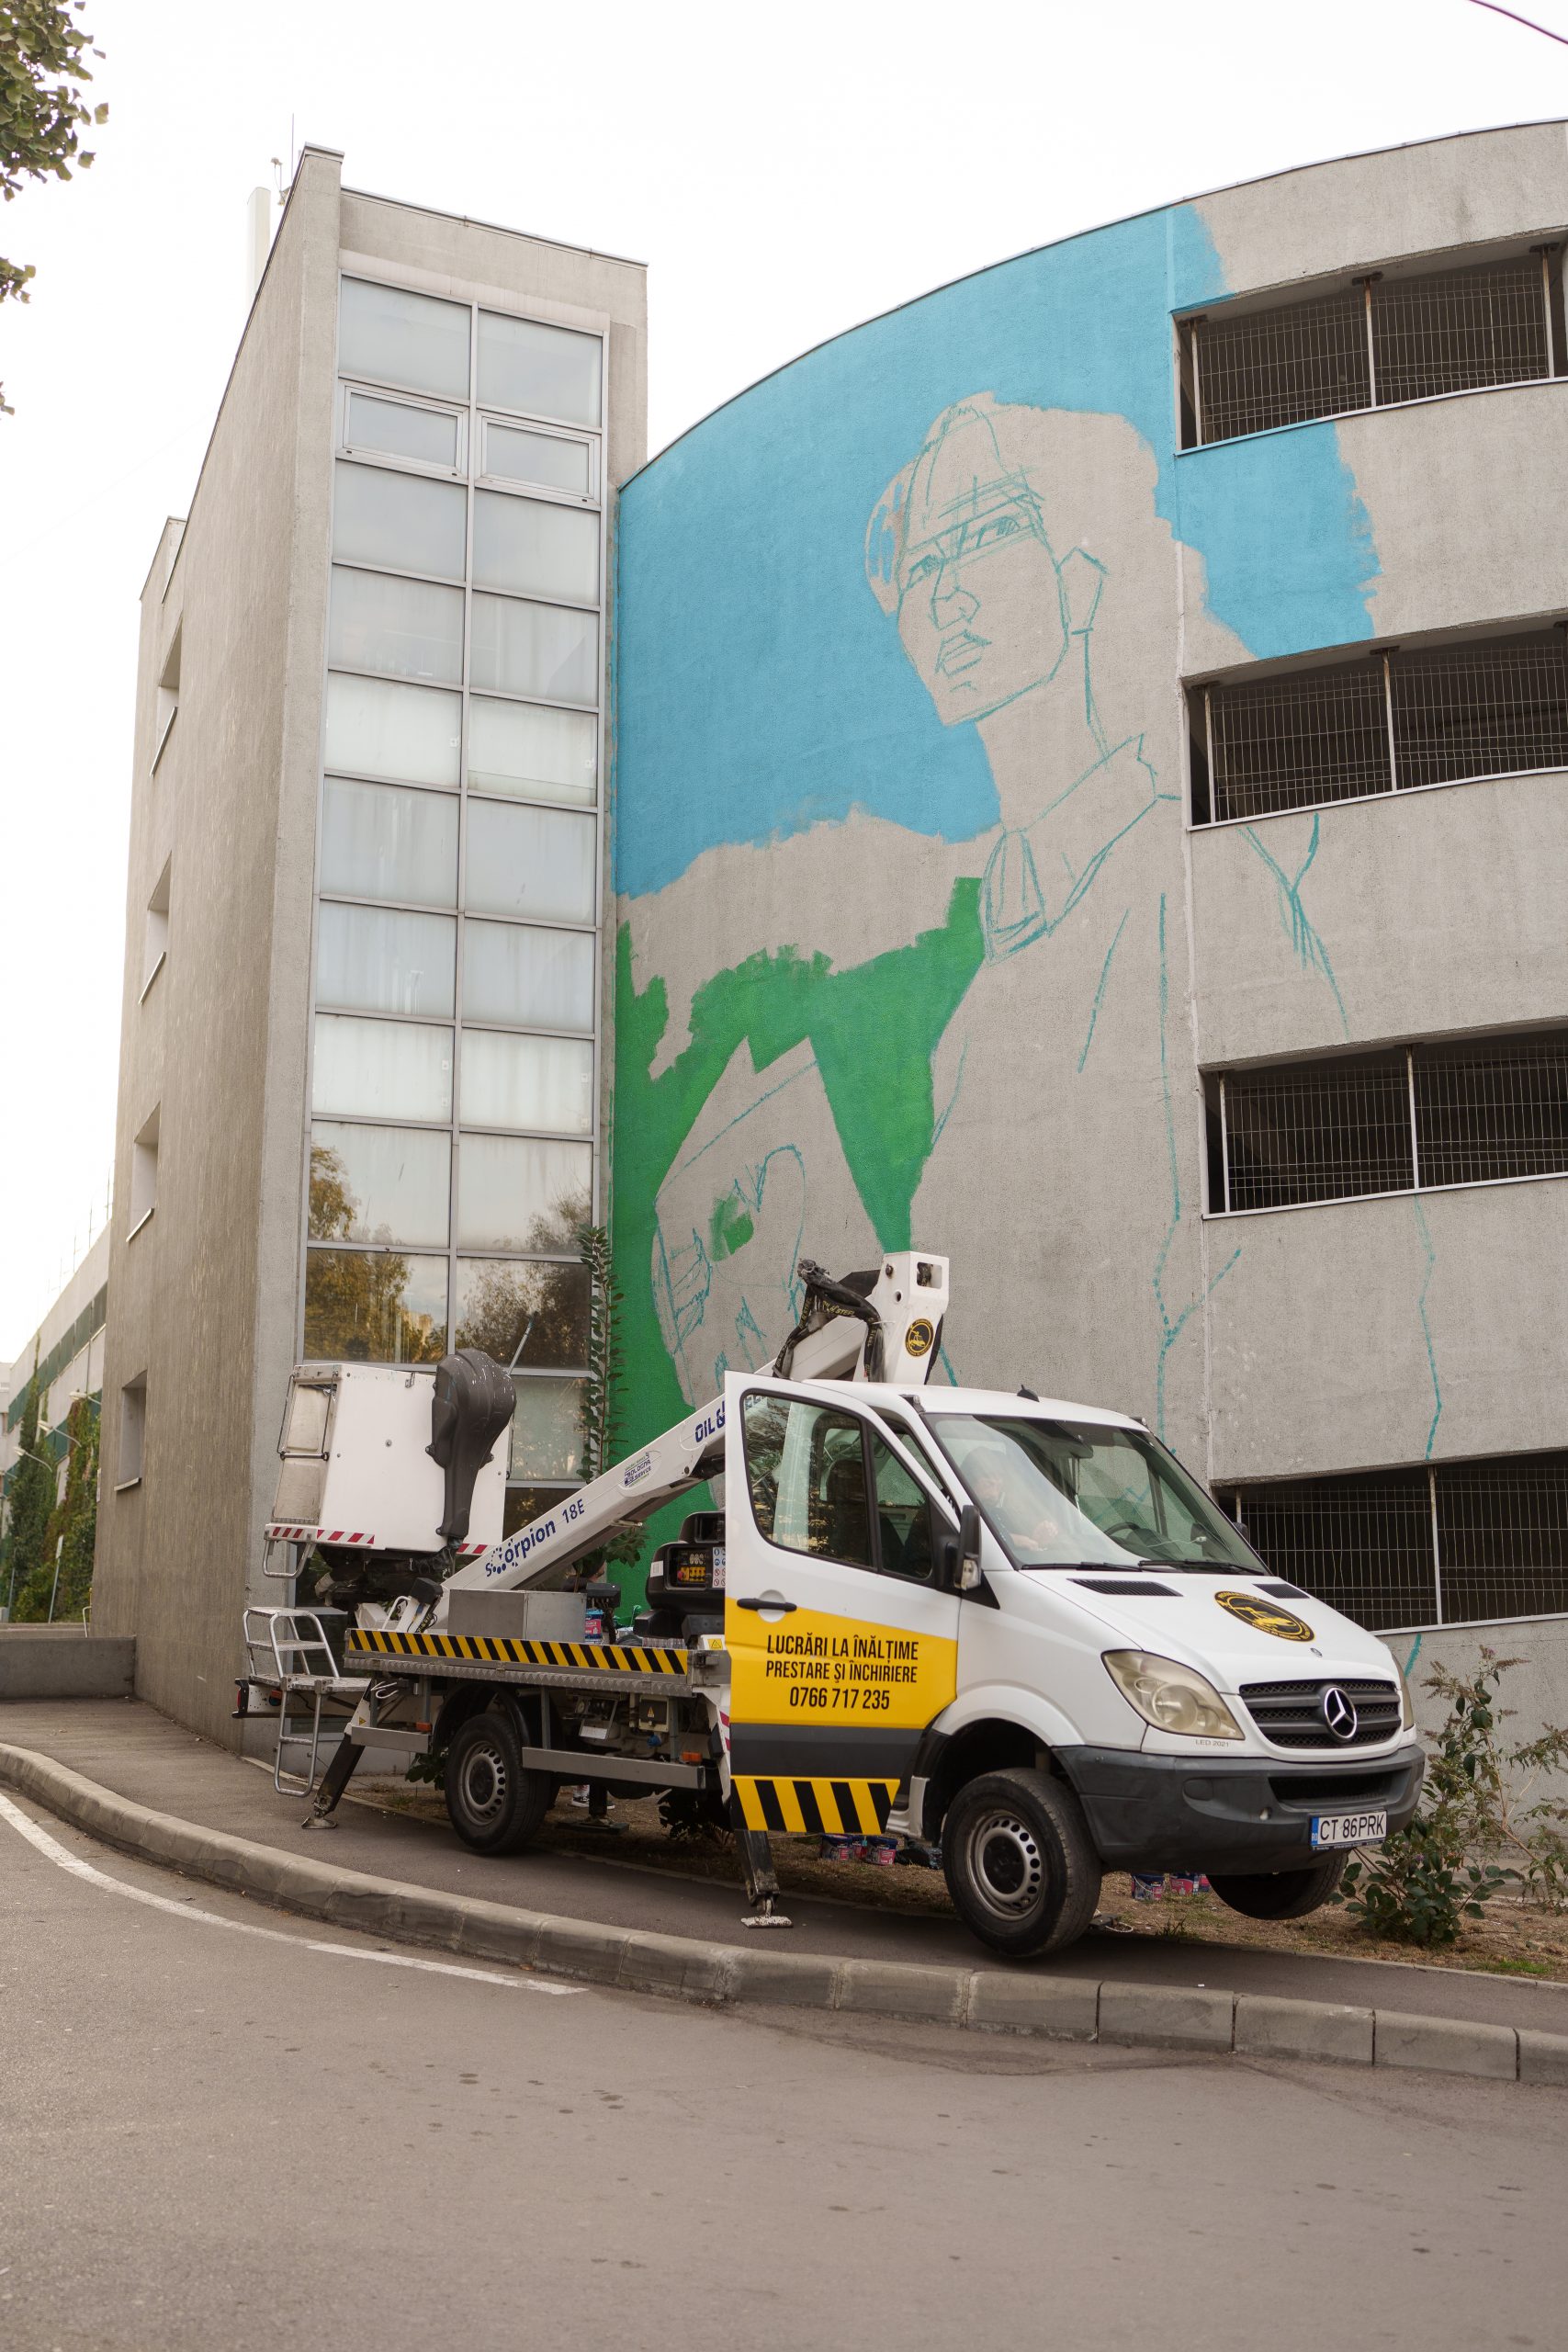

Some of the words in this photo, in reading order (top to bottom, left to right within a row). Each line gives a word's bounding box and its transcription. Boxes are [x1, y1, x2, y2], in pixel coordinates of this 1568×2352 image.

[562, 1498, 585, 1523] 18E
[767, 1632, 829, 1657] LUCRĂRI
[832, 1638, 849, 1657] LA
[766, 1660, 830, 1680] PRESTARE
[850, 1660, 918, 1683] ÎNCHIRIERE
[790, 1686, 828, 1707] 0766
[831, 1689, 859, 1709] 717
[863, 1690, 890, 1710] 235
[1320, 1820, 1338, 1840] CT
